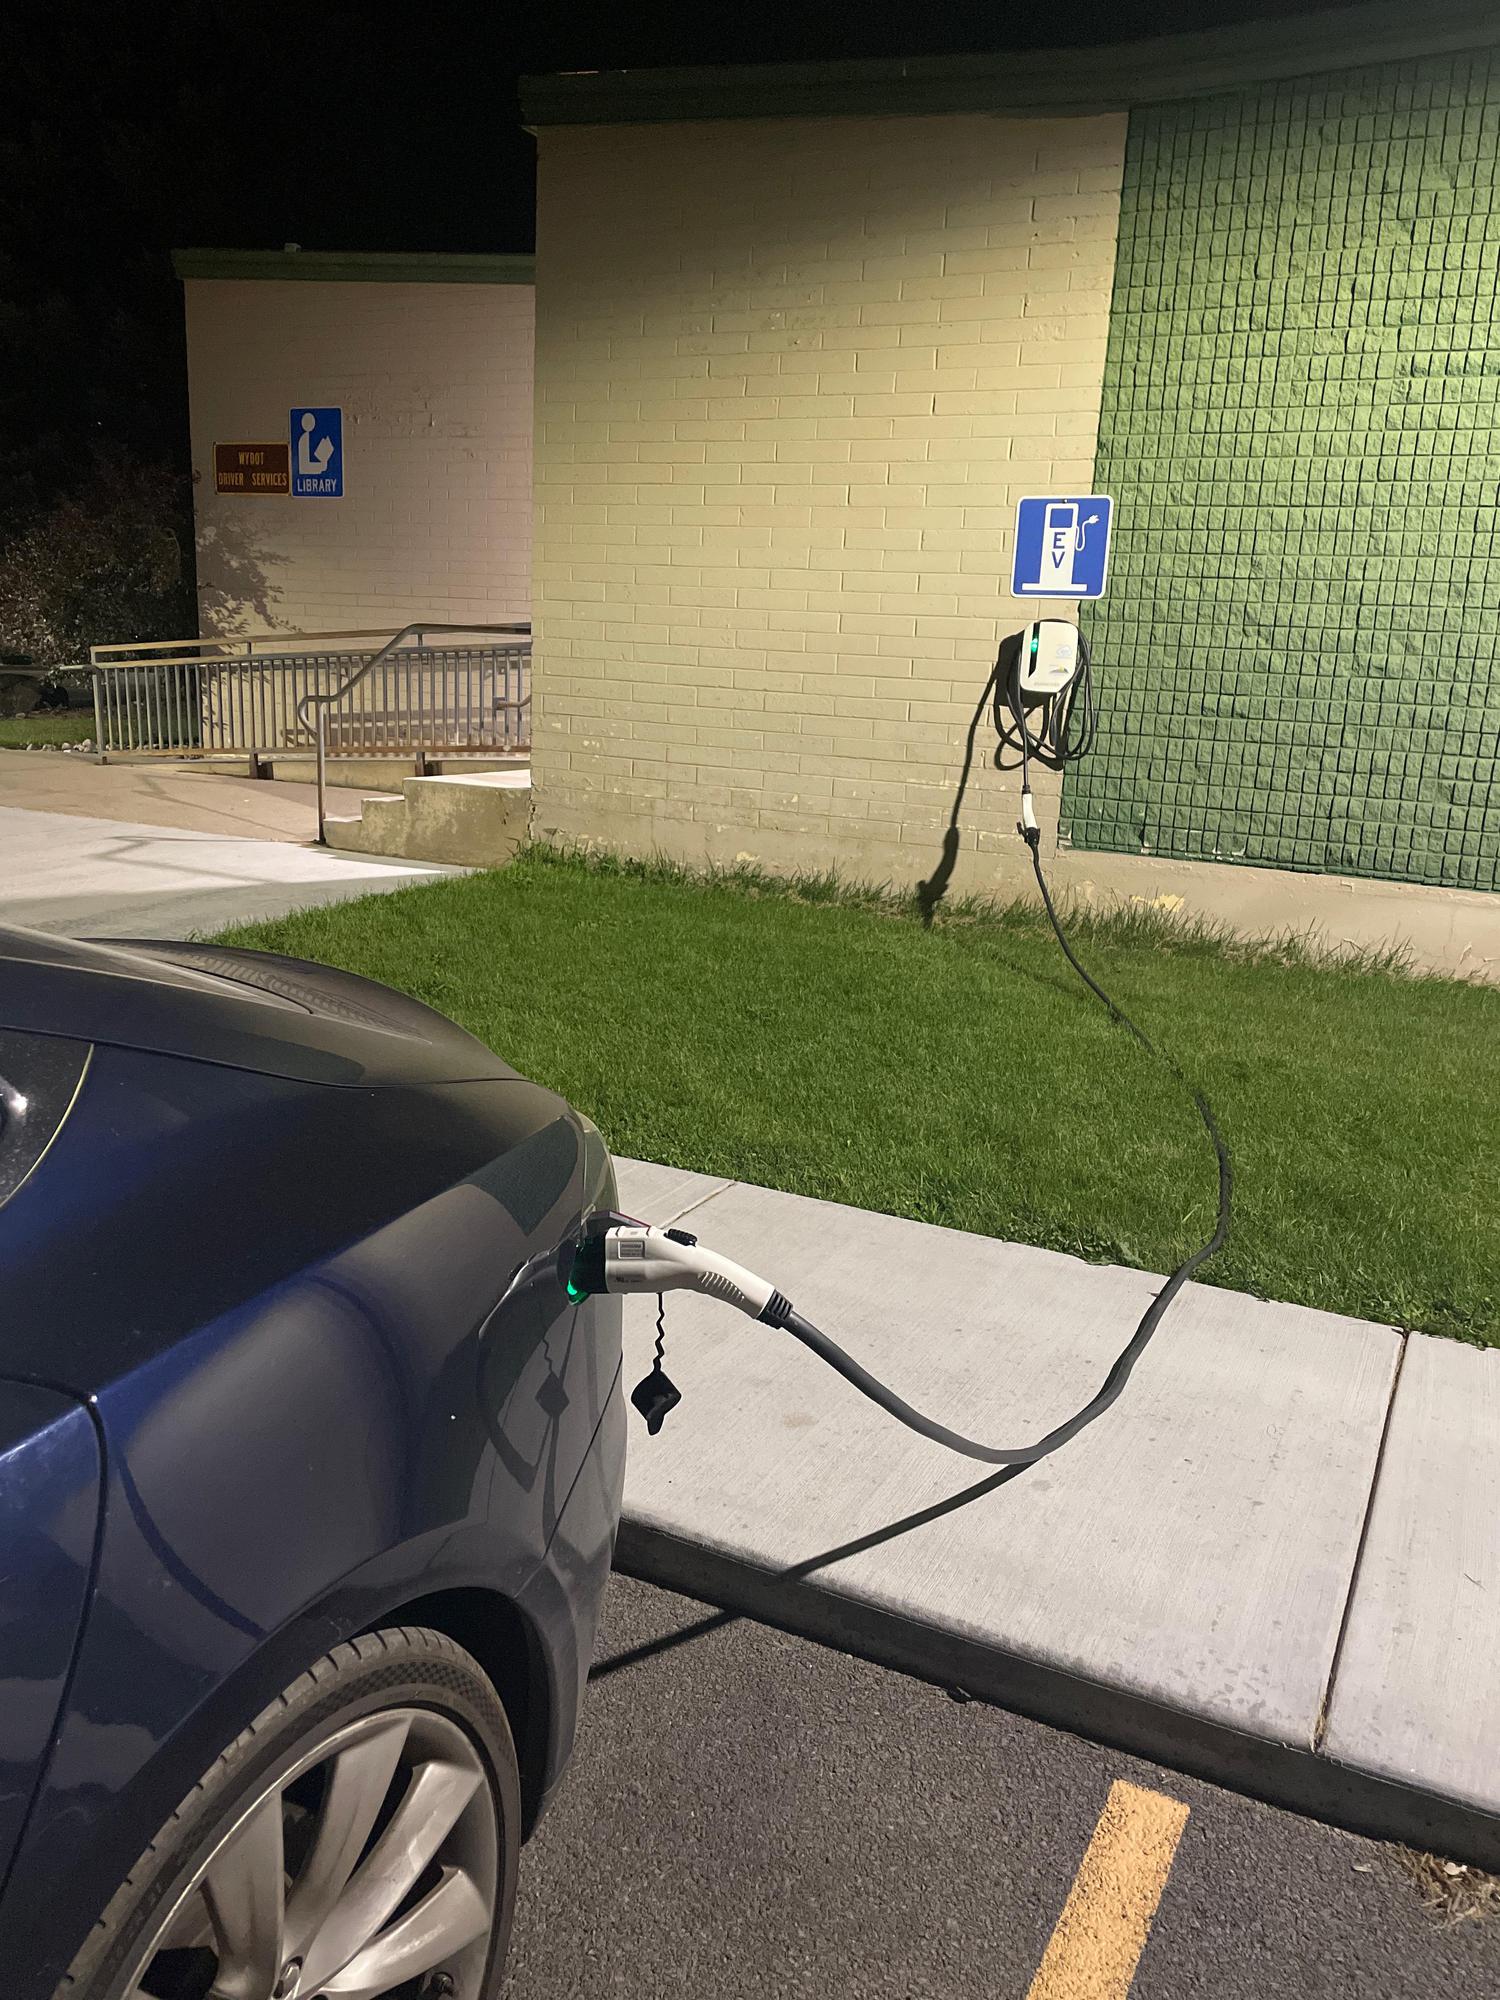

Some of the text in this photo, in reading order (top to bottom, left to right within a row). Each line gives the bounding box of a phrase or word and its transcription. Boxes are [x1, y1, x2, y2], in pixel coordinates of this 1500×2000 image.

[238, 451, 264, 465] WYDOT
[218, 472, 288, 486] DRIVER SERVICES
[297, 478, 337, 492] LIBRARY
